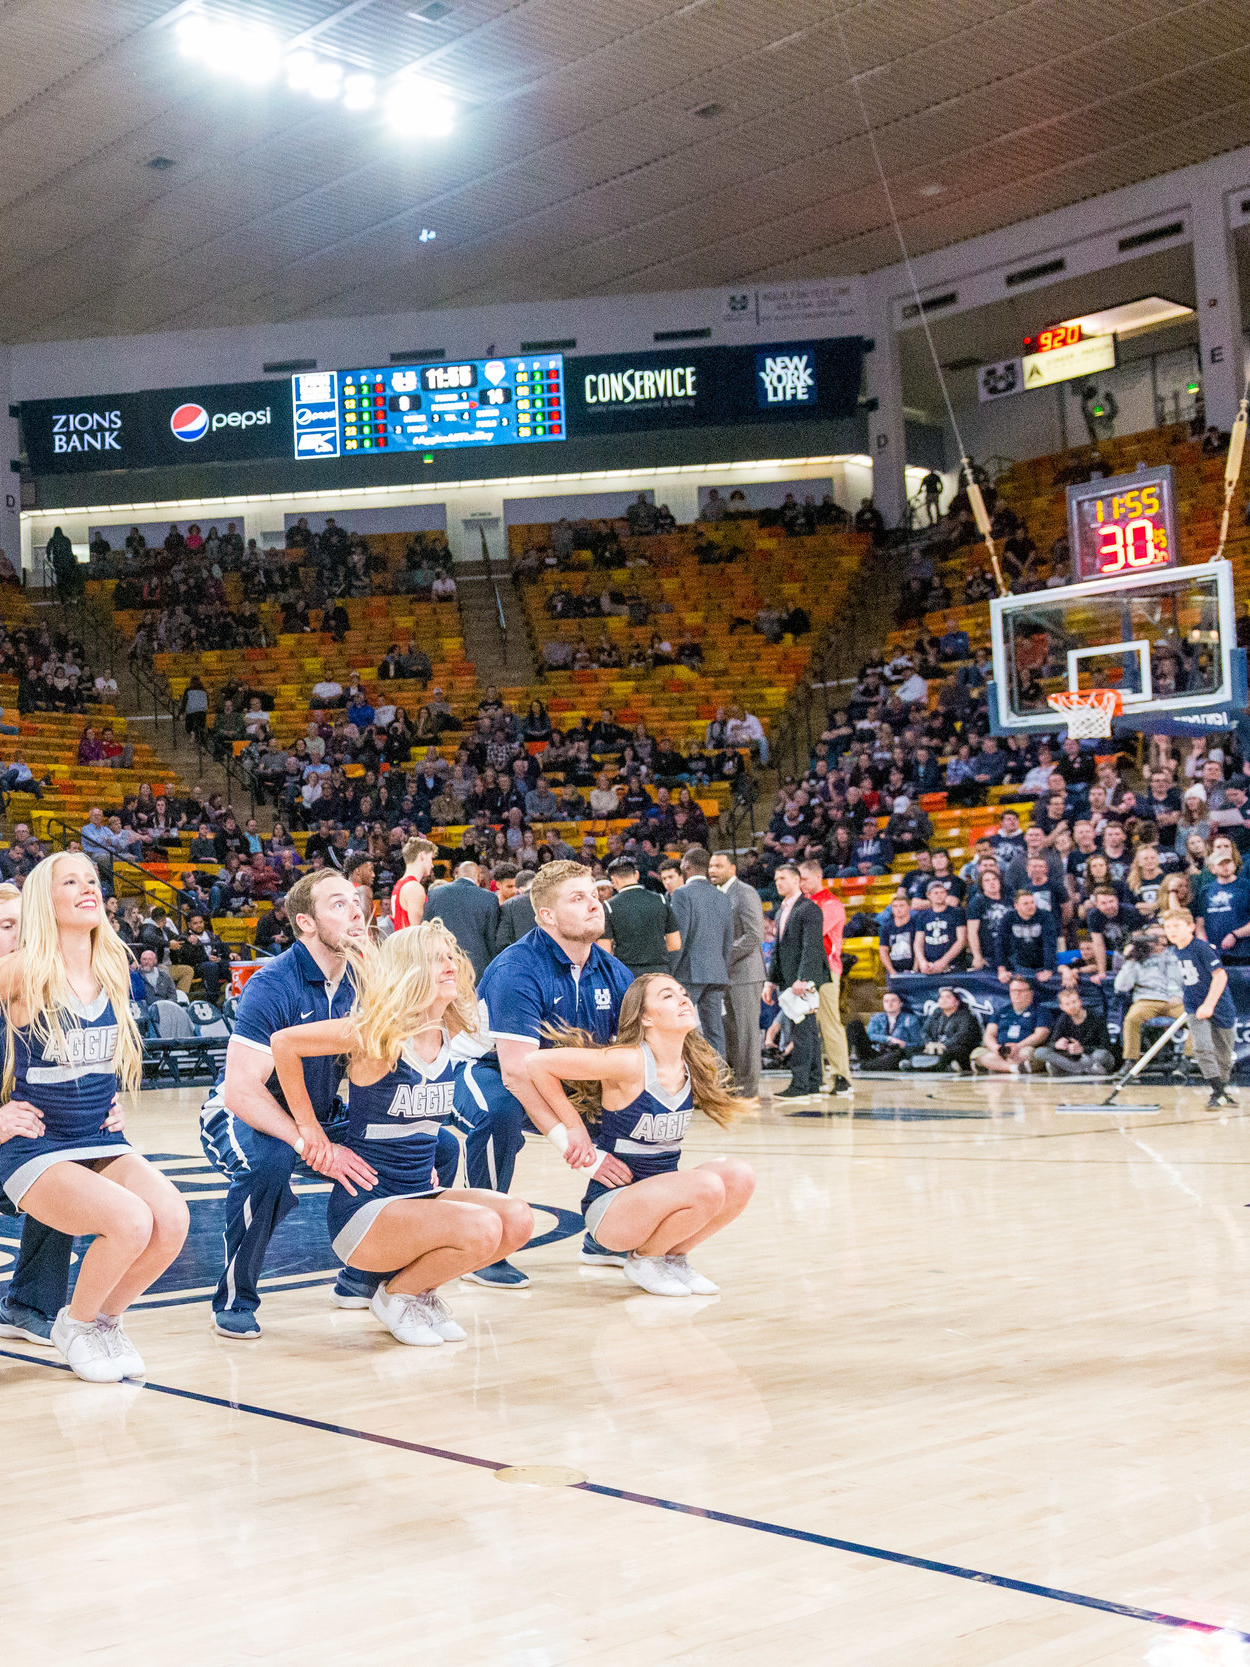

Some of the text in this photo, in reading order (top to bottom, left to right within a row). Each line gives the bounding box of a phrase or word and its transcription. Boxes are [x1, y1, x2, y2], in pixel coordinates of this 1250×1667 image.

[764, 355, 809, 374] NEW
[1211, 347, 1224, 363] E
[426, 366, 471, 389] 11:55
[758, 368, 815, 388] YORK
[767, 385, 809, 402] LIFE
[52, 410, 122, 433] ZIONS
[211, 406, 272, 431] pepsi
[53, 431, 122, 453] BANK
[6, 495, 16, 508] D
[1095, 486, 1160, 523] 11:55
[1097, 518, 1154, 573] 30
[42, 1025, 118, 1064] AGGIE
[387, 1081, 455, 1118] AGGIE
[629, 1108, 694, 1141] AGGIE
